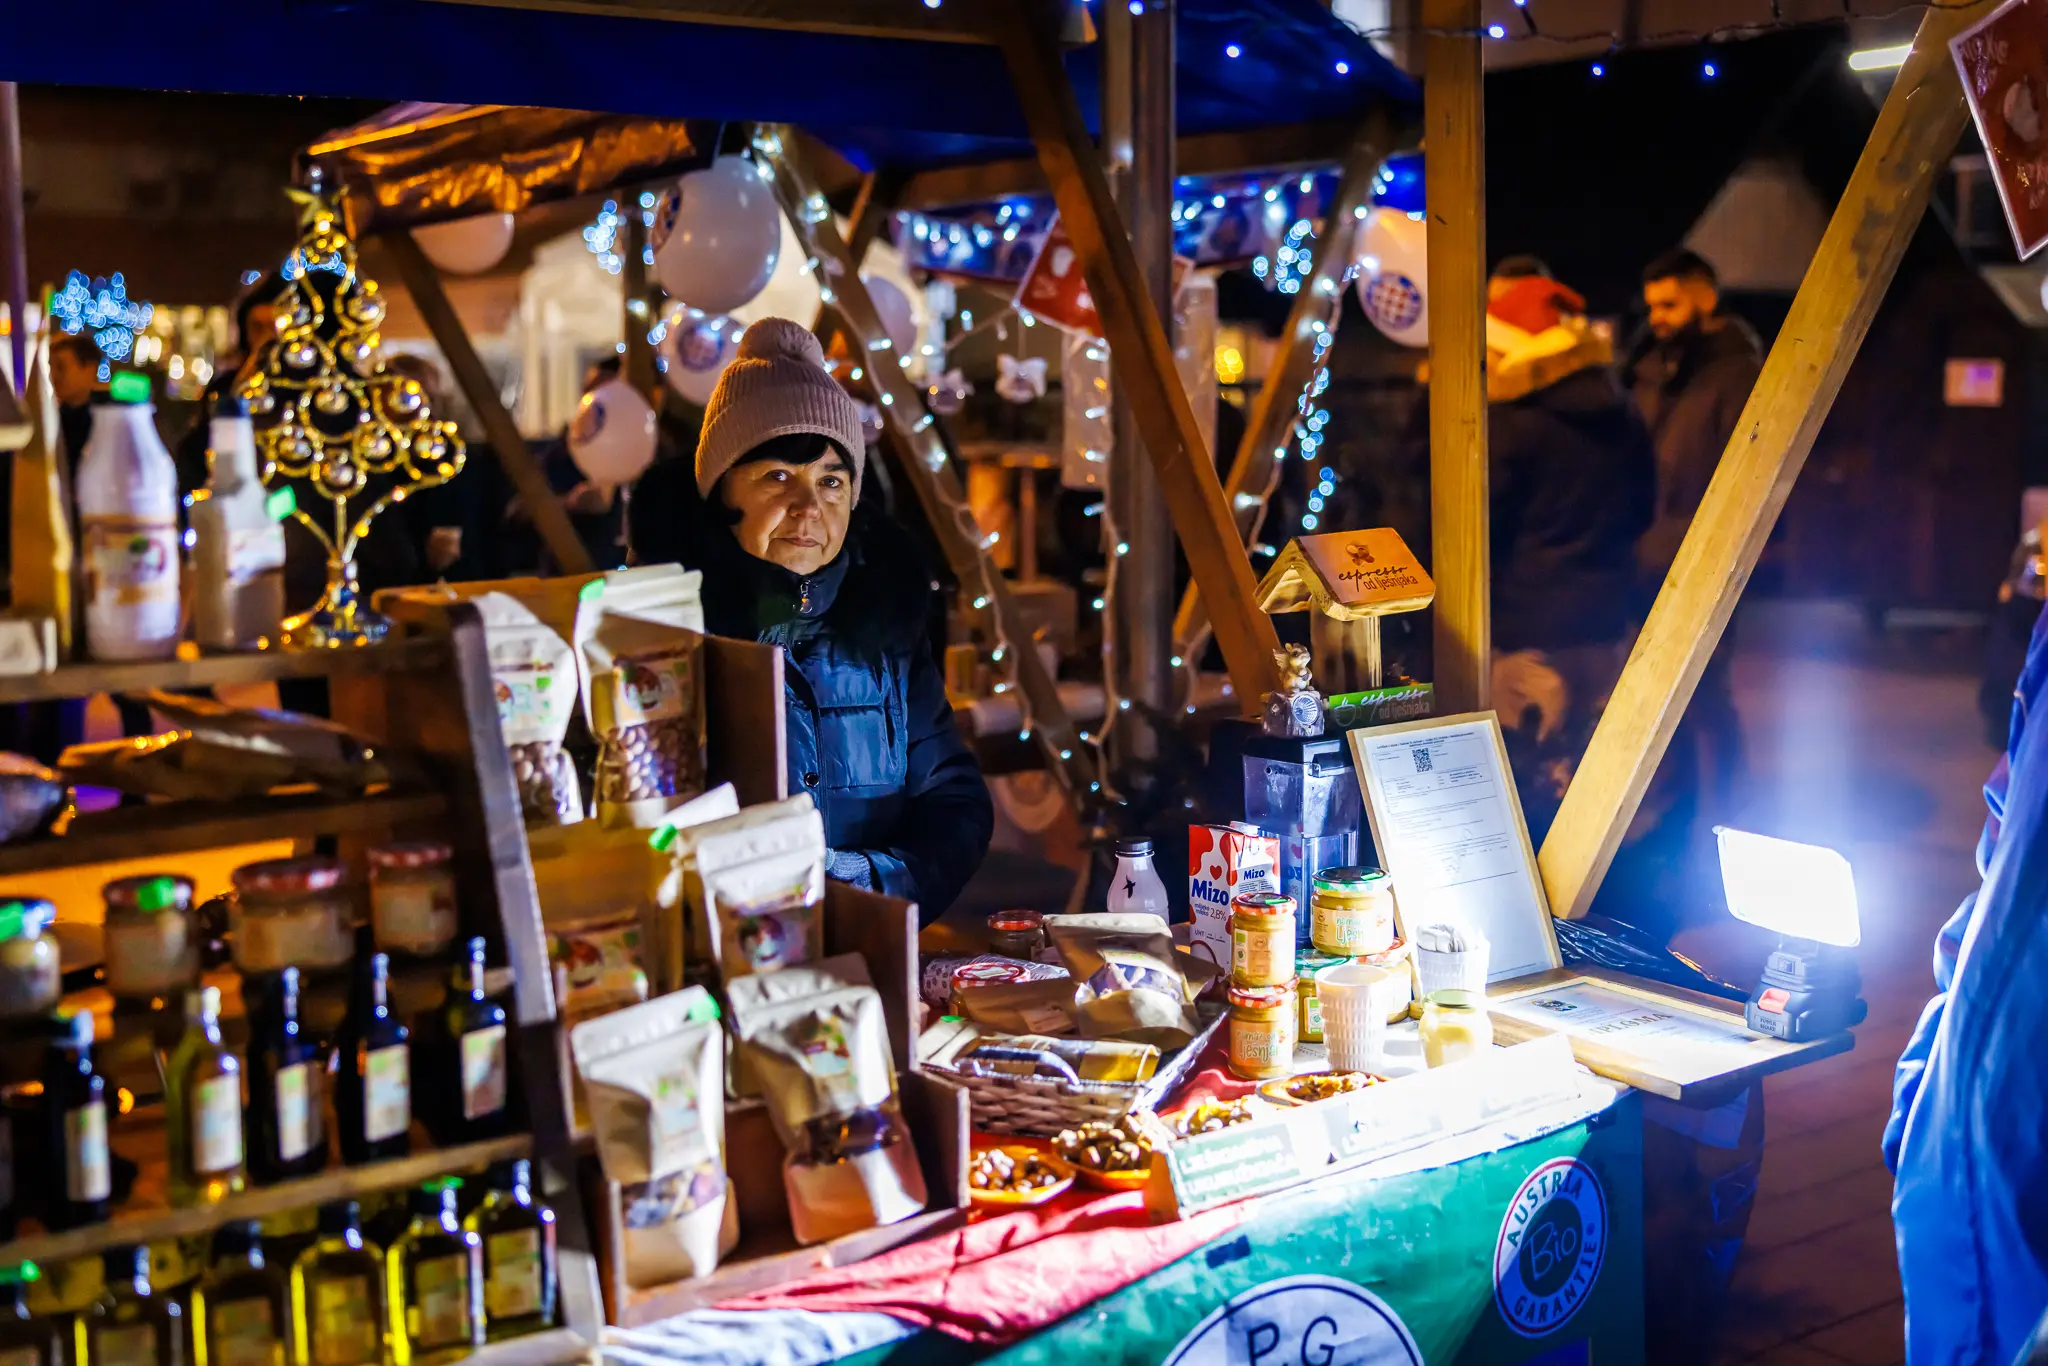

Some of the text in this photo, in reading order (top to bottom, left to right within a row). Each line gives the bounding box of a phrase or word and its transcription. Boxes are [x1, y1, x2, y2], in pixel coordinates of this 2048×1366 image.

[1338, 566, 1408, 592] espresso
[1363, 574, 1418, 590] od lješnjaka
[1361, 688, 1429, 722] espresso
[1380, 705, 1391, 718] od
[1243, 868, 1265, 881] Mizo
[1191, 878, 1229, 906] Mizo
[1210, 907, 1227, 922] 2,8%
[1507, 1171, 1583, 1248] AUSTRIA
[1522, 1221, 1577, 1281] Bio
[1513, 1241, 1598, 1324] GARANTIE
